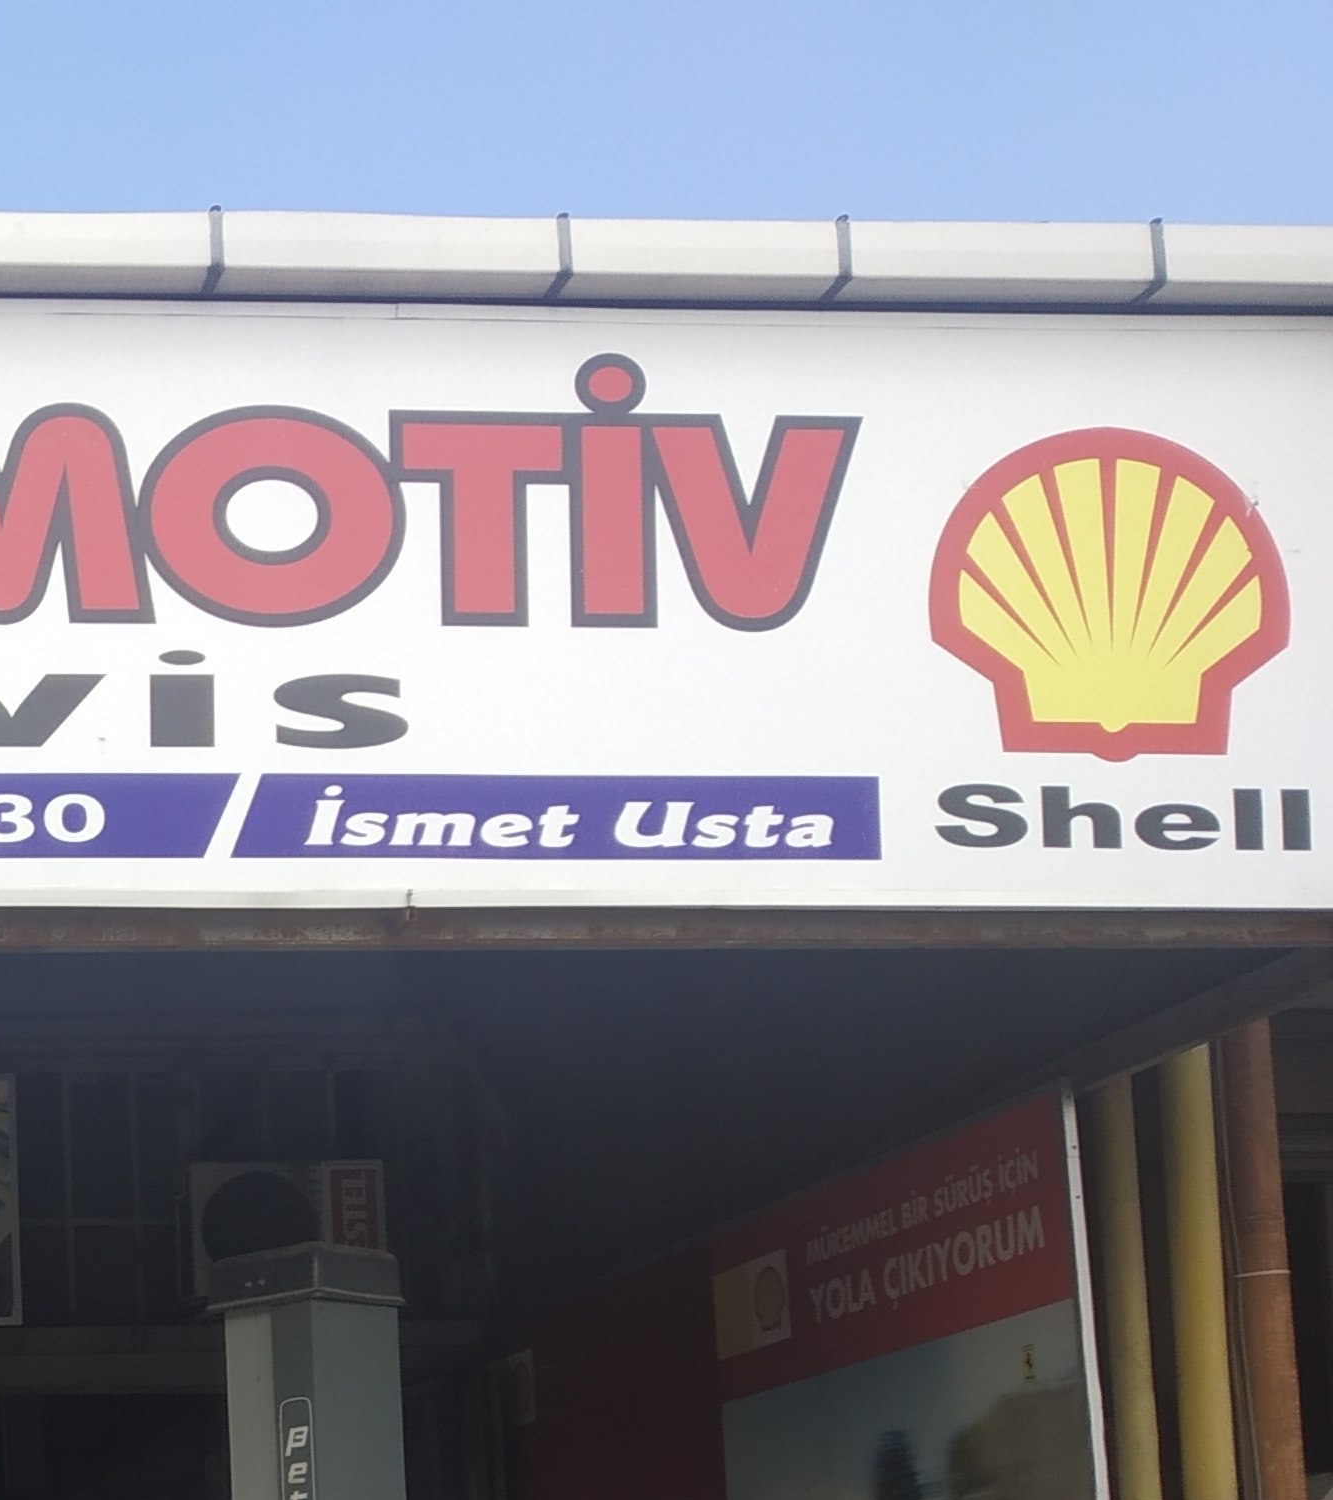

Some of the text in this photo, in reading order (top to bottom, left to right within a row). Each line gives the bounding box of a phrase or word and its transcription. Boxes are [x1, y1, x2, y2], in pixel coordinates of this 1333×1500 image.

[305, 785, 834, 850] İsmet Usta
[934, 783, 1312, 852] Shell
[806, 1208, 899, 1265] MÜKEMMEL
[900, 1190, 931, 1231] BİR
[808, 1204, 1046, 1324] YOLA ÇIKIYORUM
